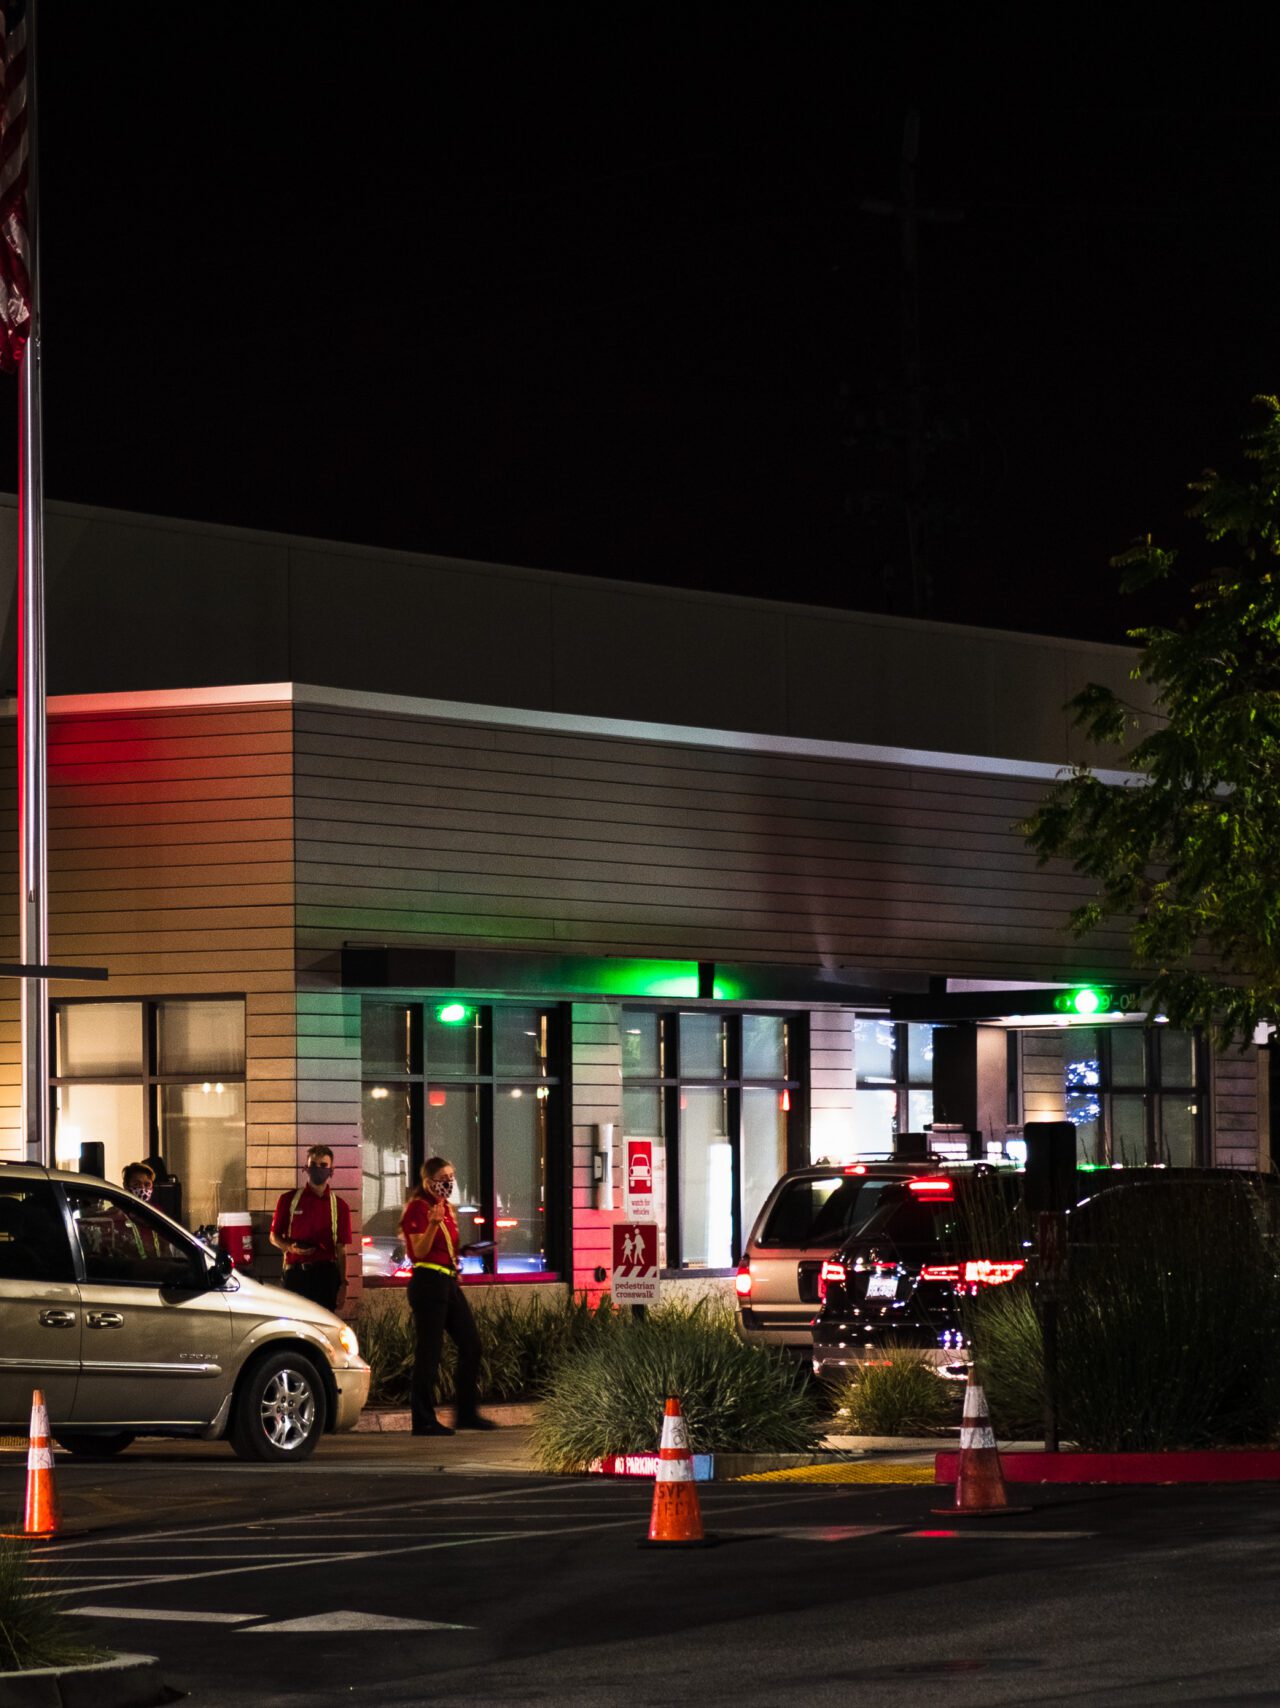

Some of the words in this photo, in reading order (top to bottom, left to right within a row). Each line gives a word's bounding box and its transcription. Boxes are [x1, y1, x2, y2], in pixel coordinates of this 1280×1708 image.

[615, 1282, 655, 1291] pedestrian
[616, 1290, 653, 1299] crosswalk
[615, 1457, 624, 1473] NO
[626, 1456, 659, 1476] PARKING
[658, 1484, 685, 1499] SVP
